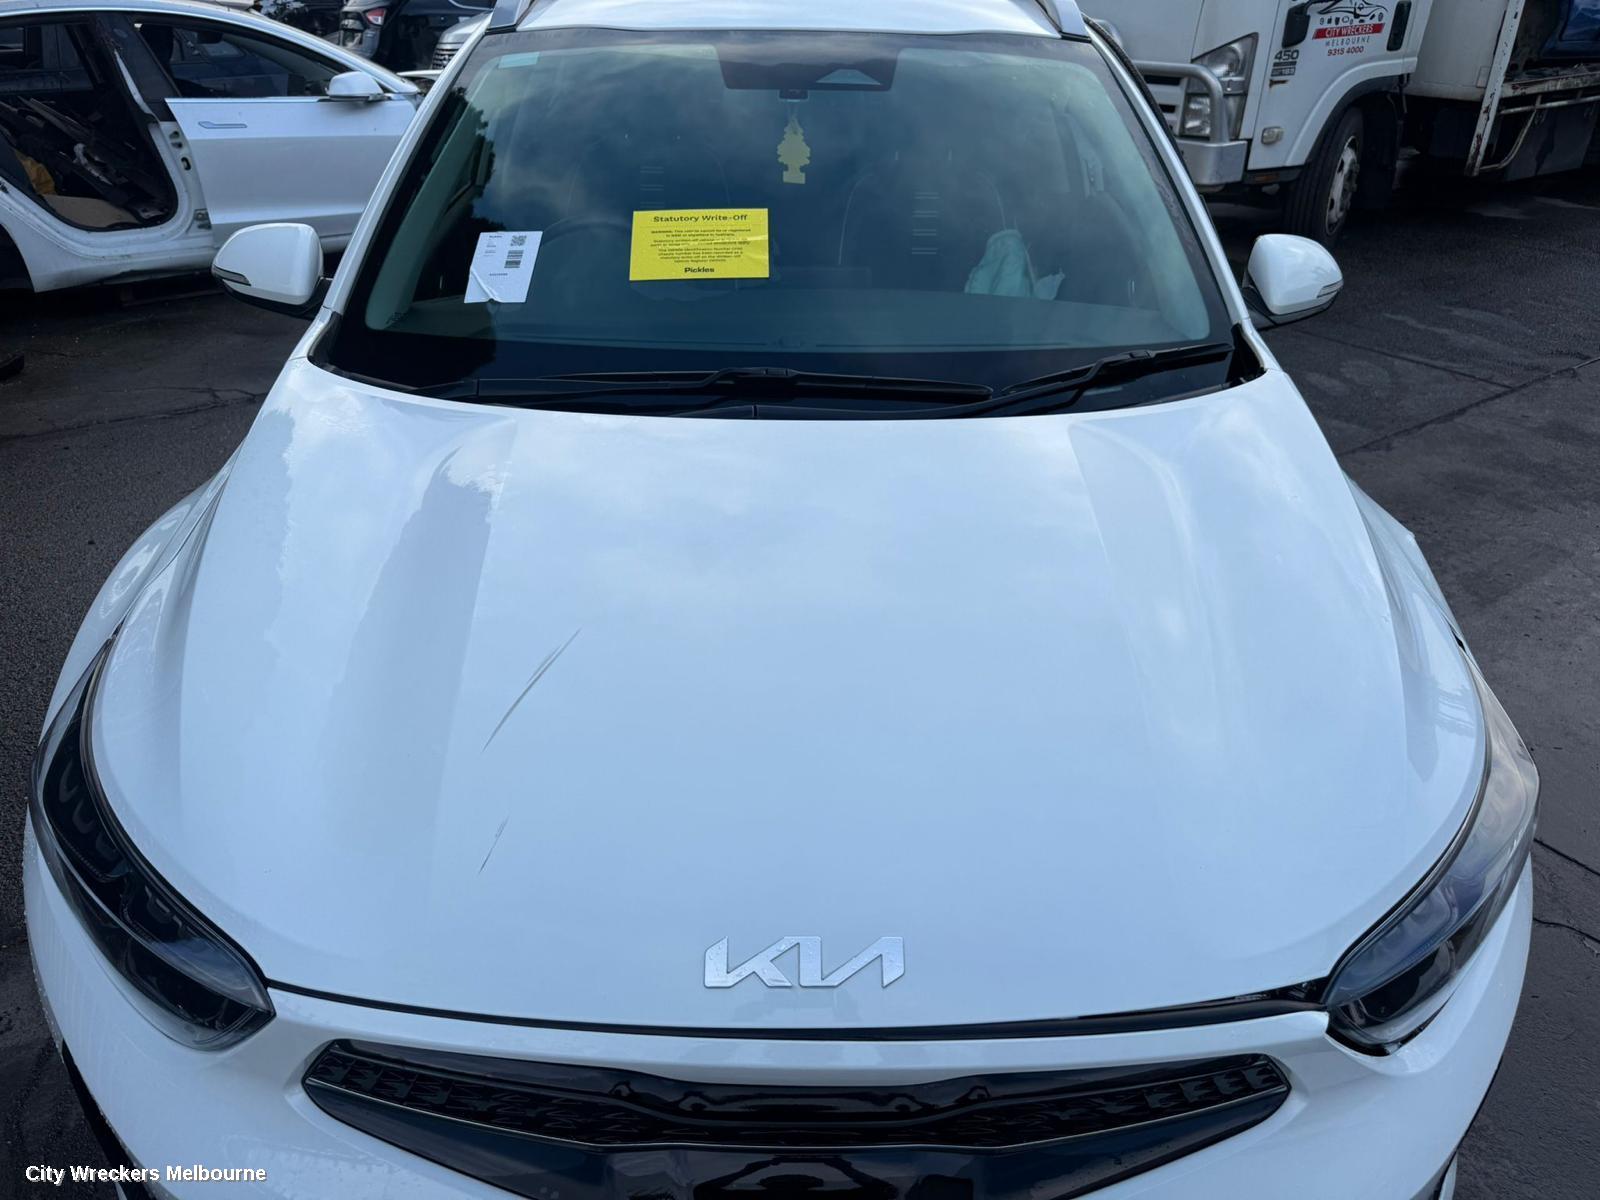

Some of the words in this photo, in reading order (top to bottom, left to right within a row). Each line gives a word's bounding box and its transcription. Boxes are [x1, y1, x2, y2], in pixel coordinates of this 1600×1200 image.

[1325, 28, 1340, 36] CITY
[1341, 24, 1374, 35] WRECKERS
[1325, 36, 1370, 46] MELBOURNE
[1274, 50, 1300, 60] 450
[1327, 48, 1345, 56] 9315
[1346, 46, 1364, 54] 4000
[653, 215, 700, 223] Statutory
[704, 936, 905, 988] KIA
